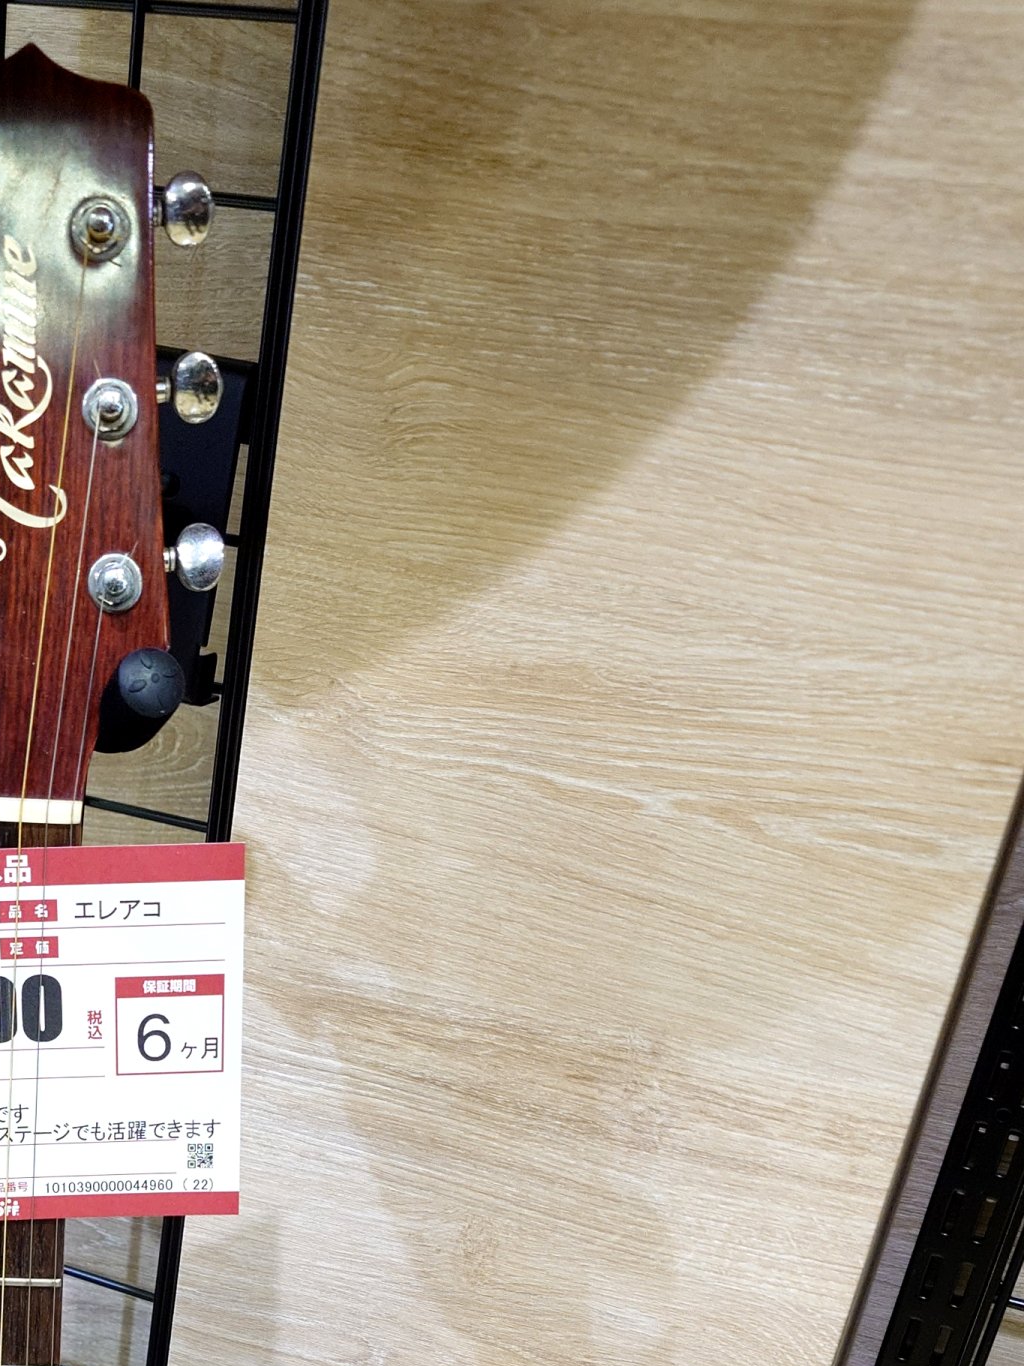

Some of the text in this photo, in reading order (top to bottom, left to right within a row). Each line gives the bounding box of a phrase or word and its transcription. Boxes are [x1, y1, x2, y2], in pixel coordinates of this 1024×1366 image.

[74, 900, 161, 920] エレアコ
[143, 979, 196, 994] 保証期間
[45, 1179, 173, 1194] 1010390000044960
